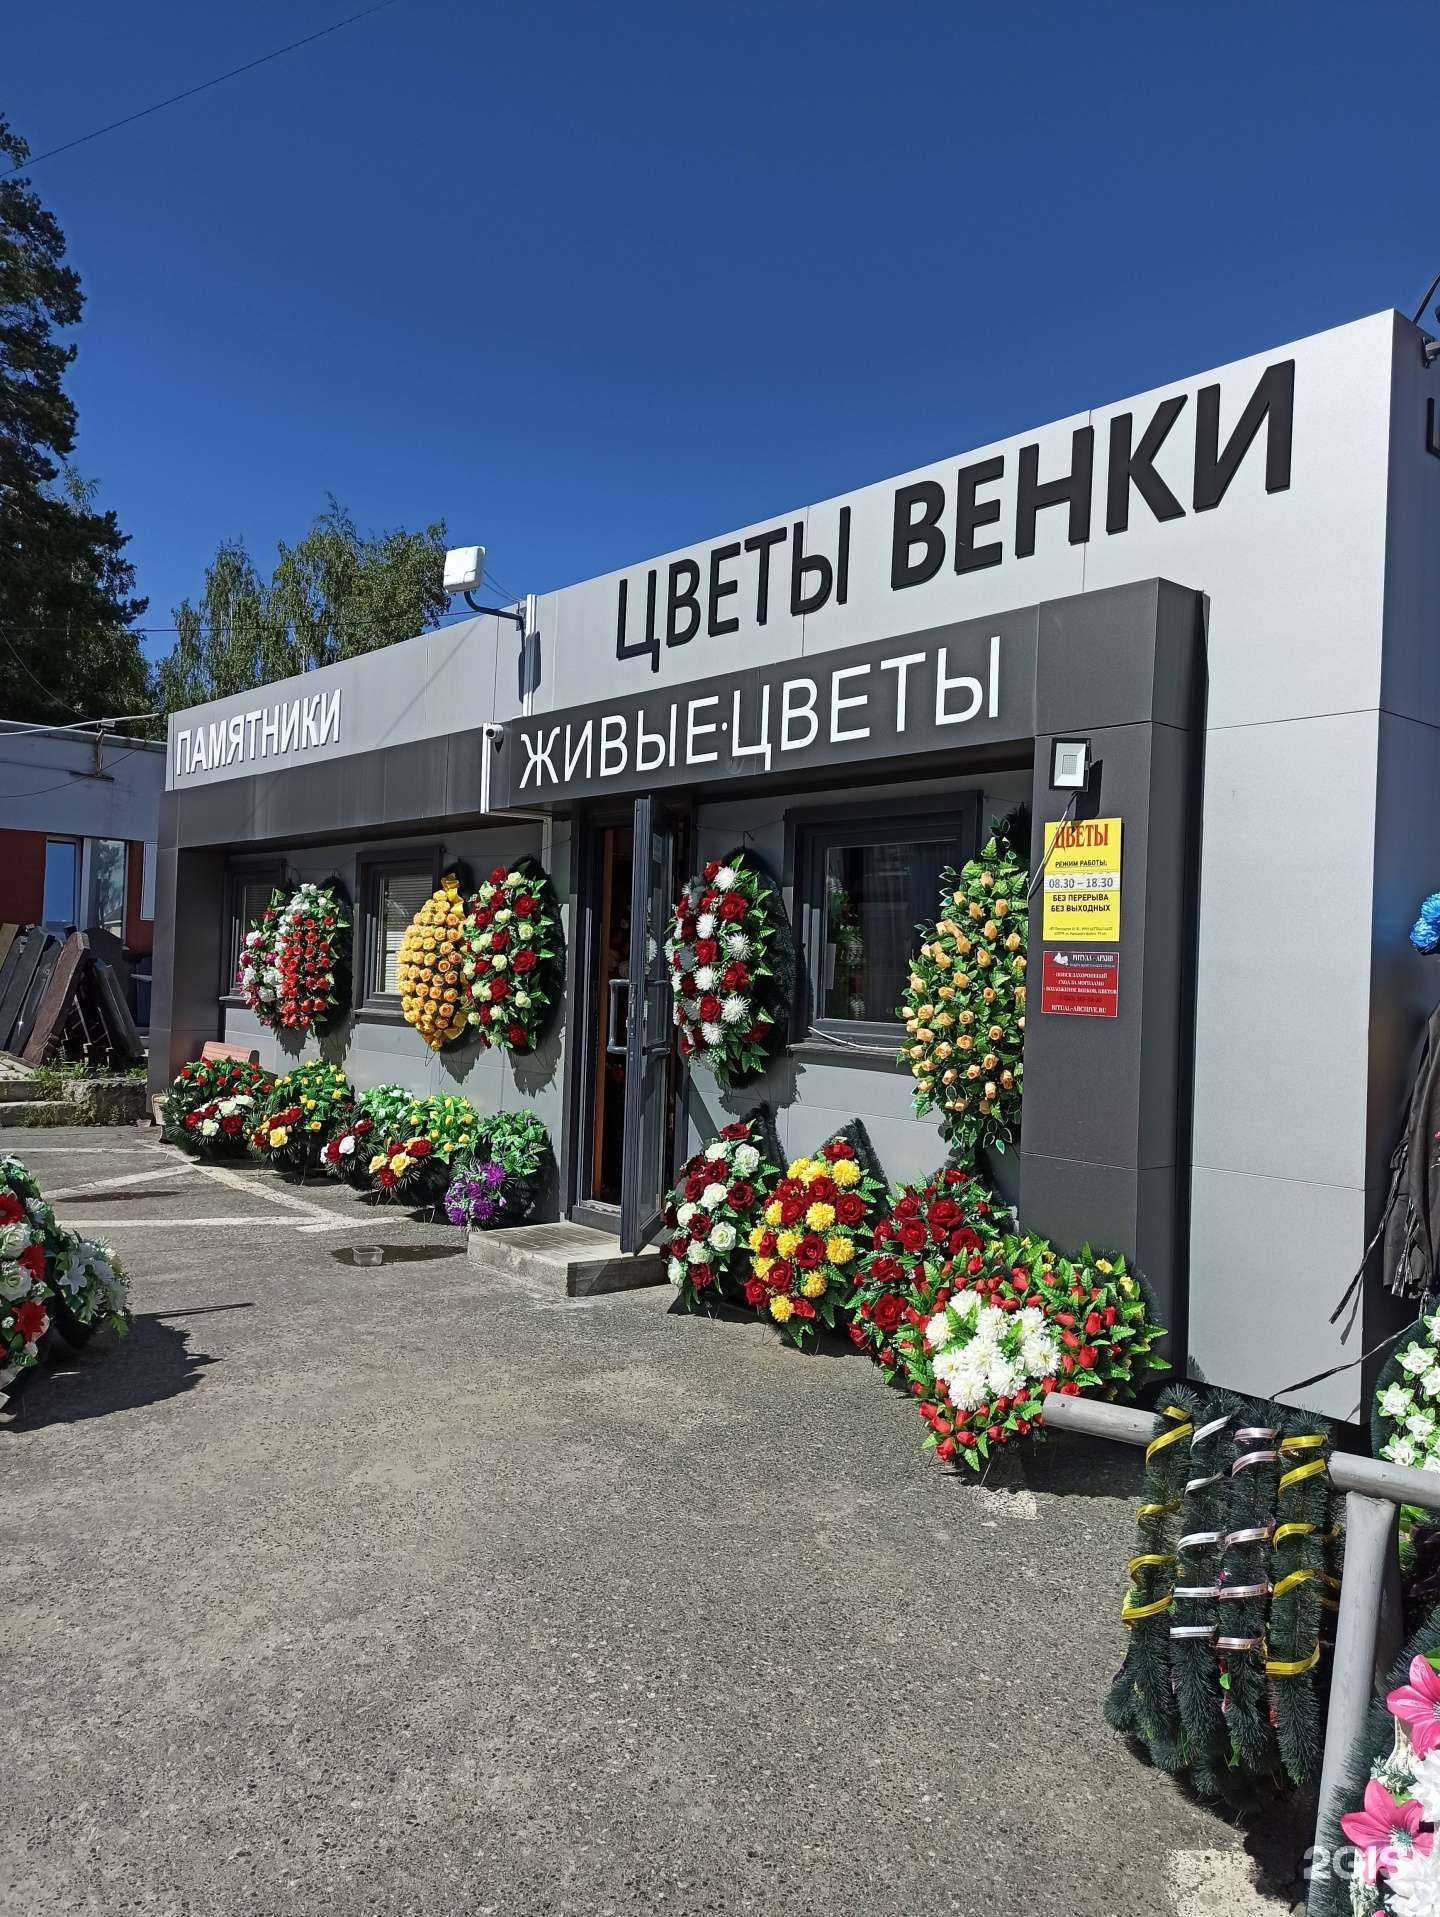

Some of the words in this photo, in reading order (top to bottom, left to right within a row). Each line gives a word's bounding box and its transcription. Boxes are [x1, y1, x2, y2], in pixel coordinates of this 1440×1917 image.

[615, 505, 851, 672] ЦВЕТЫ
[891, 359, 1295, 590] ВЕНКИ
[732, 636, 1001, 771] ЦВЕТЫ
[176, 689, 343, 776] ПАМЯТНИКИ
[1055, 823, 1109, 851] ЦВЕТЫ
[1055, 860, 1079, 868] РЕЖИМ
[1049, 878, 1075, 889] 08.30
[1086, 877, 1113, 888] 18.30
[1053, 894, 1066, 902] БЕЗ
[1068, 893, 1109, 901] ПЕРЕРЫВА
[1066, 904, 1110, 912] ВЫХОДНЫХ
